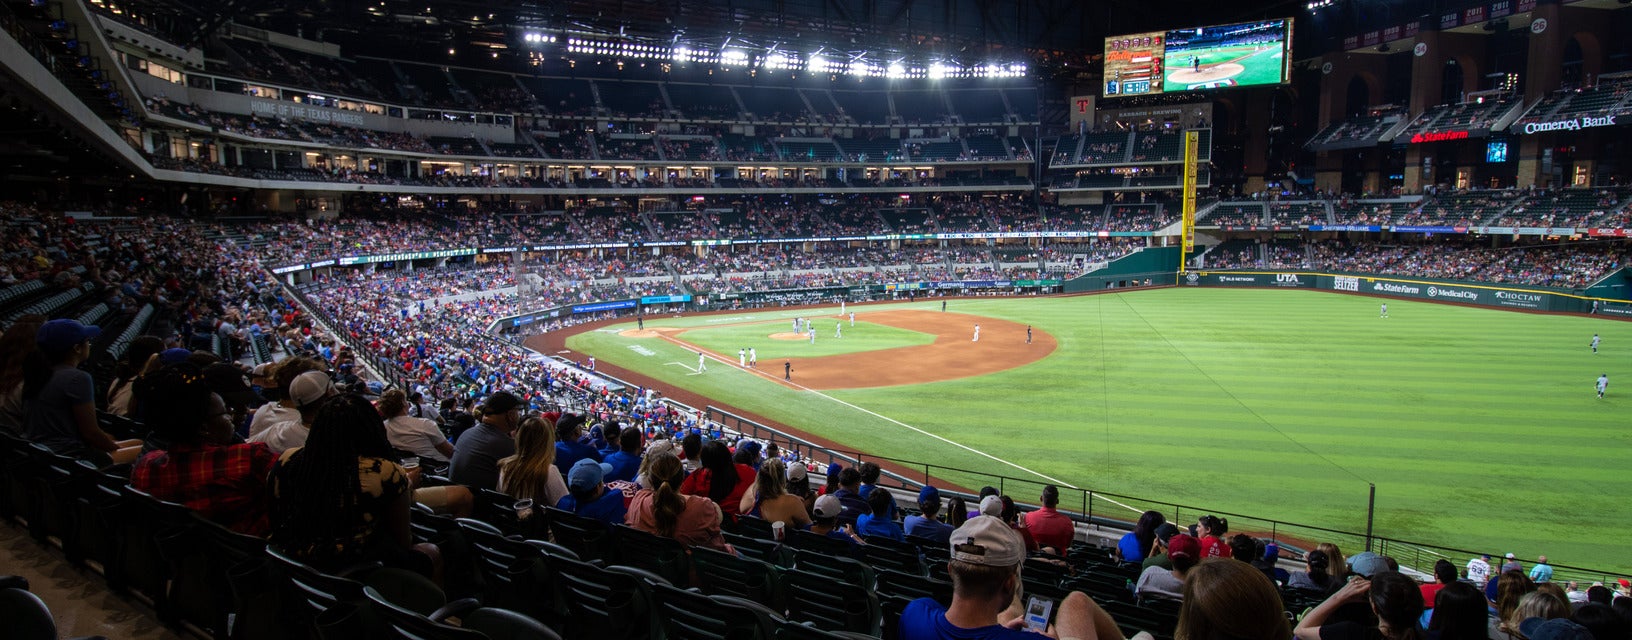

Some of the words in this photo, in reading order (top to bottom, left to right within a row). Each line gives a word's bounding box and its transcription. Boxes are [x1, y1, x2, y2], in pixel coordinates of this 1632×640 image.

[1492, 1, 1509, 11] 2011
[1466, 7, 1483, 17] 2011
[1533, 21, 1545, 31] 26
[1076, 99, 1089, 114] T
[251, 100, 276, 114] HOME
[279, 105, 289, 115] OF
[291, 106, 306, 117] THE
[307, 108, 331, 121] TEXAS
[332, 112, 364, 125] RANGERS
[1582, 115, 1616, 128] Bank
[1276, 274, 1298, 282] UTA
[1333, 280, 1359, 292] SELTZER
[1438, 289, 1463, 298] Medical
[1464, 291, 1478, 301] City
[1500, 291, 1541, 301] CHOCTAW
[1471, 565, 1482, 575] 63
